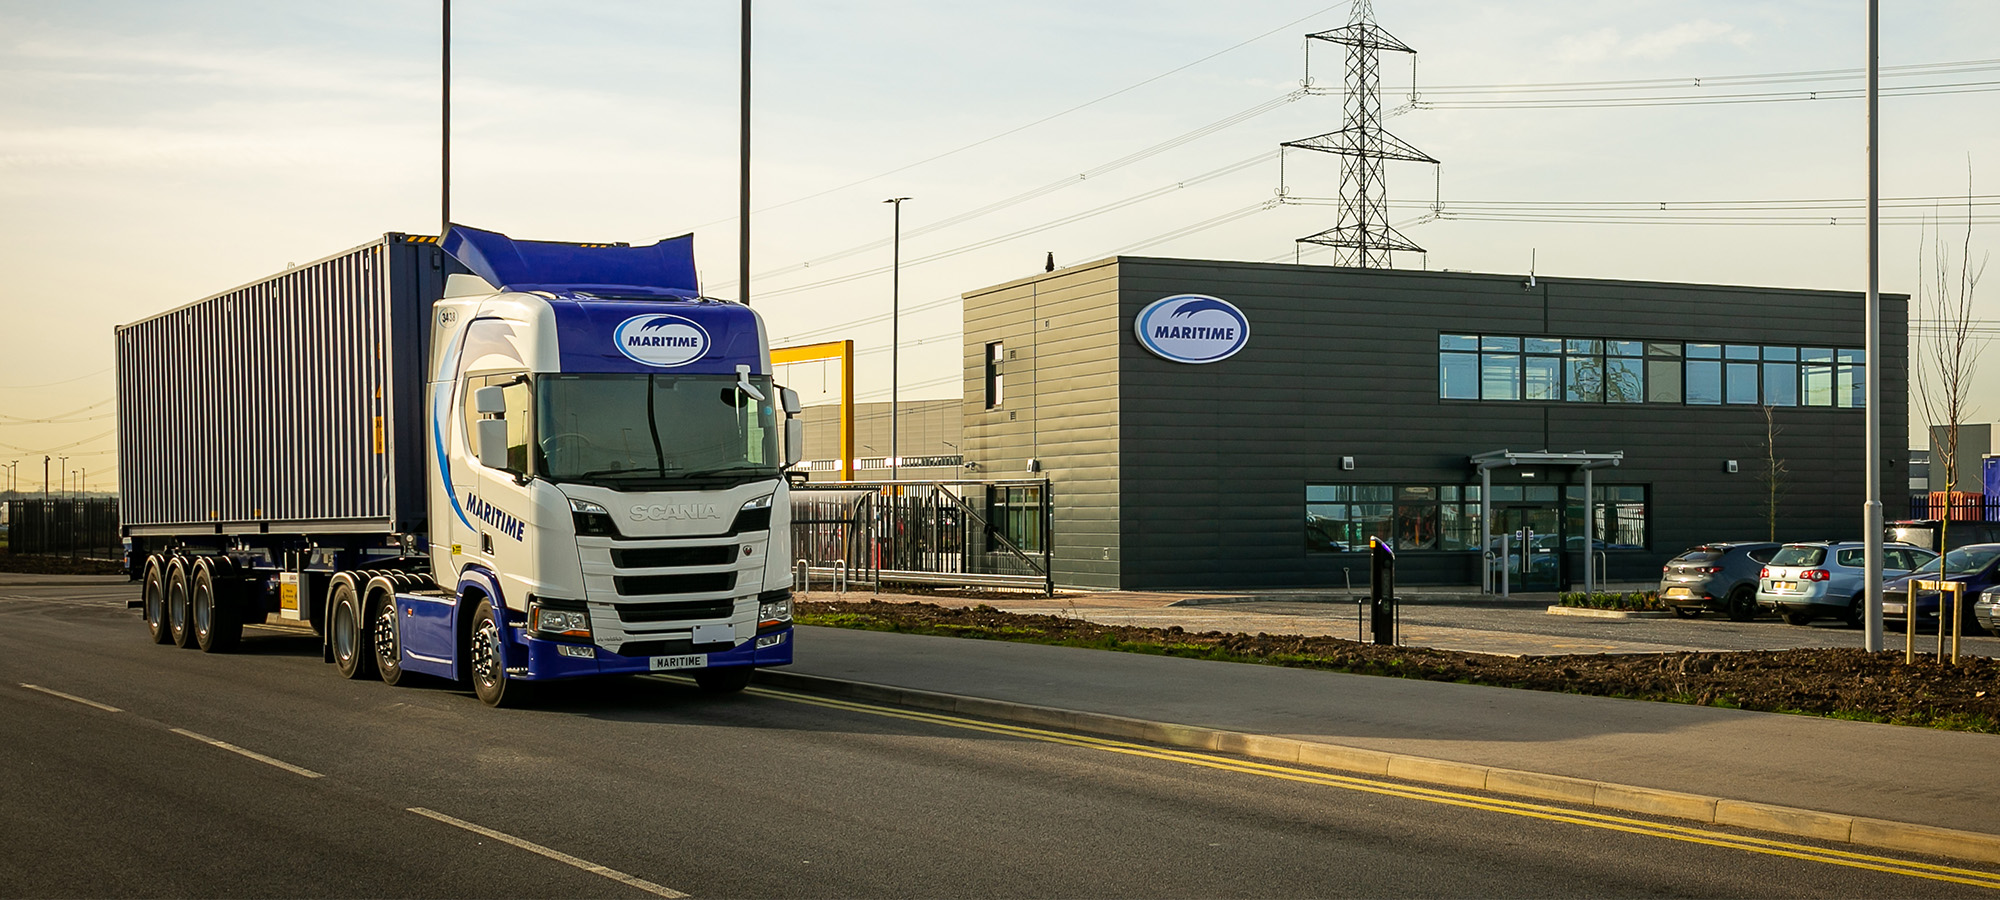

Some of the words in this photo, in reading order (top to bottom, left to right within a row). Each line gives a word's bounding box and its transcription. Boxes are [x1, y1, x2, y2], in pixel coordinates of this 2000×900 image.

[1154, 326, 1235, 340] MARITIME
[628, 336, 698, 347] MARITIME
[466, 492, 525, 542] MARITIME
[630, 503, 720, 521] SCANIA
[657, 657, 701, 668] MARITIME
